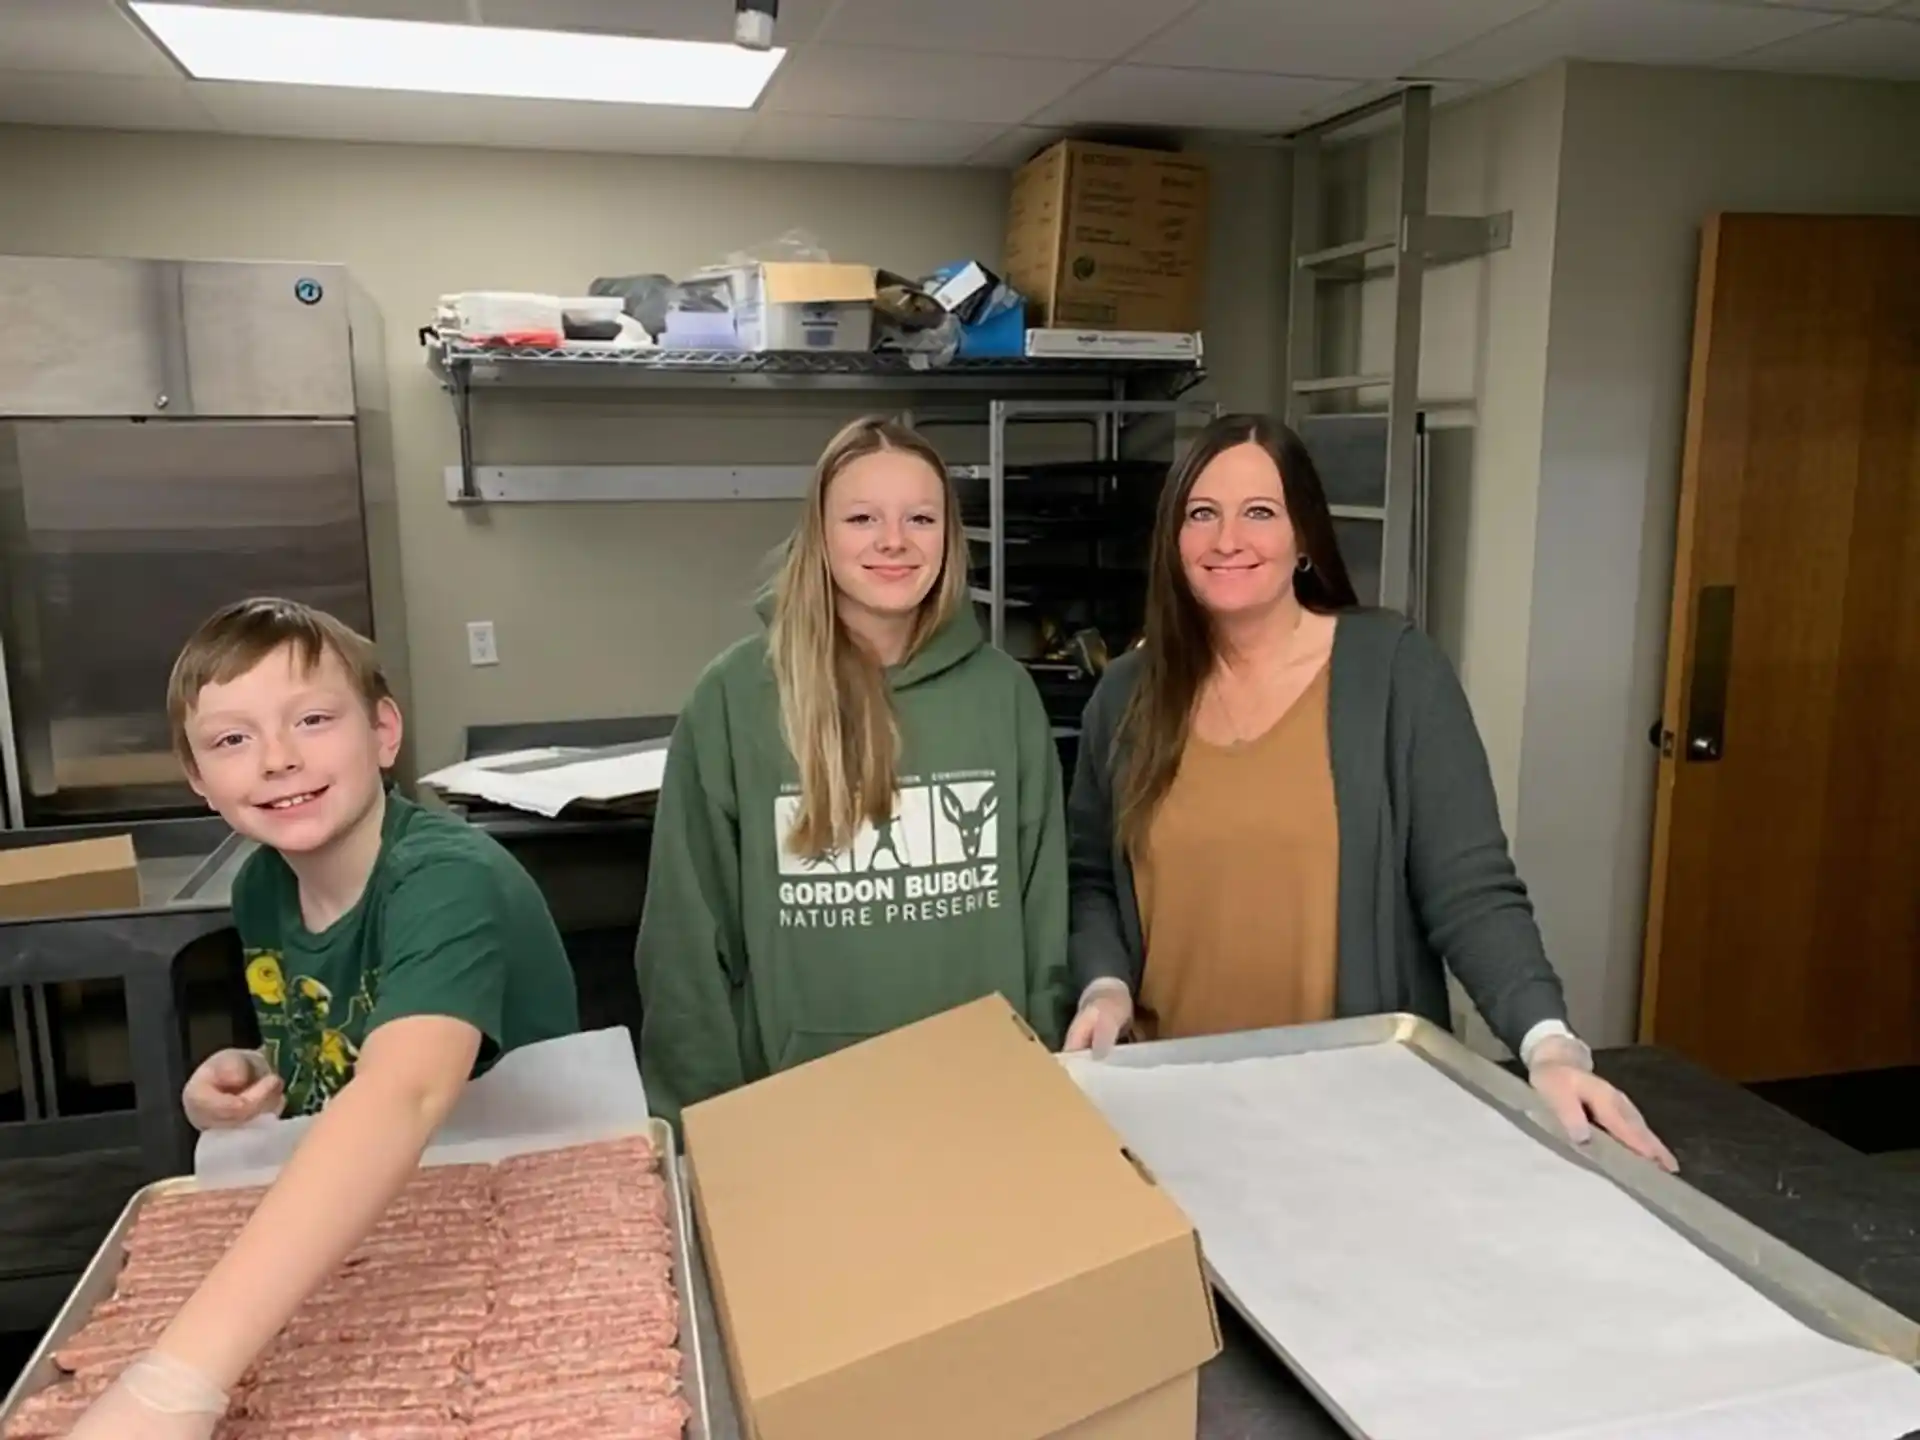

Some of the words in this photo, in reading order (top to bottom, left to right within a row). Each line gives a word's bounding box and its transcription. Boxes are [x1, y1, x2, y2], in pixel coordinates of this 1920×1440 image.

[778, 876, 895, 905] GORDON
[905, 864, 998, 899] BUBOLZ
[779, 906, 873, 928] NATURE
